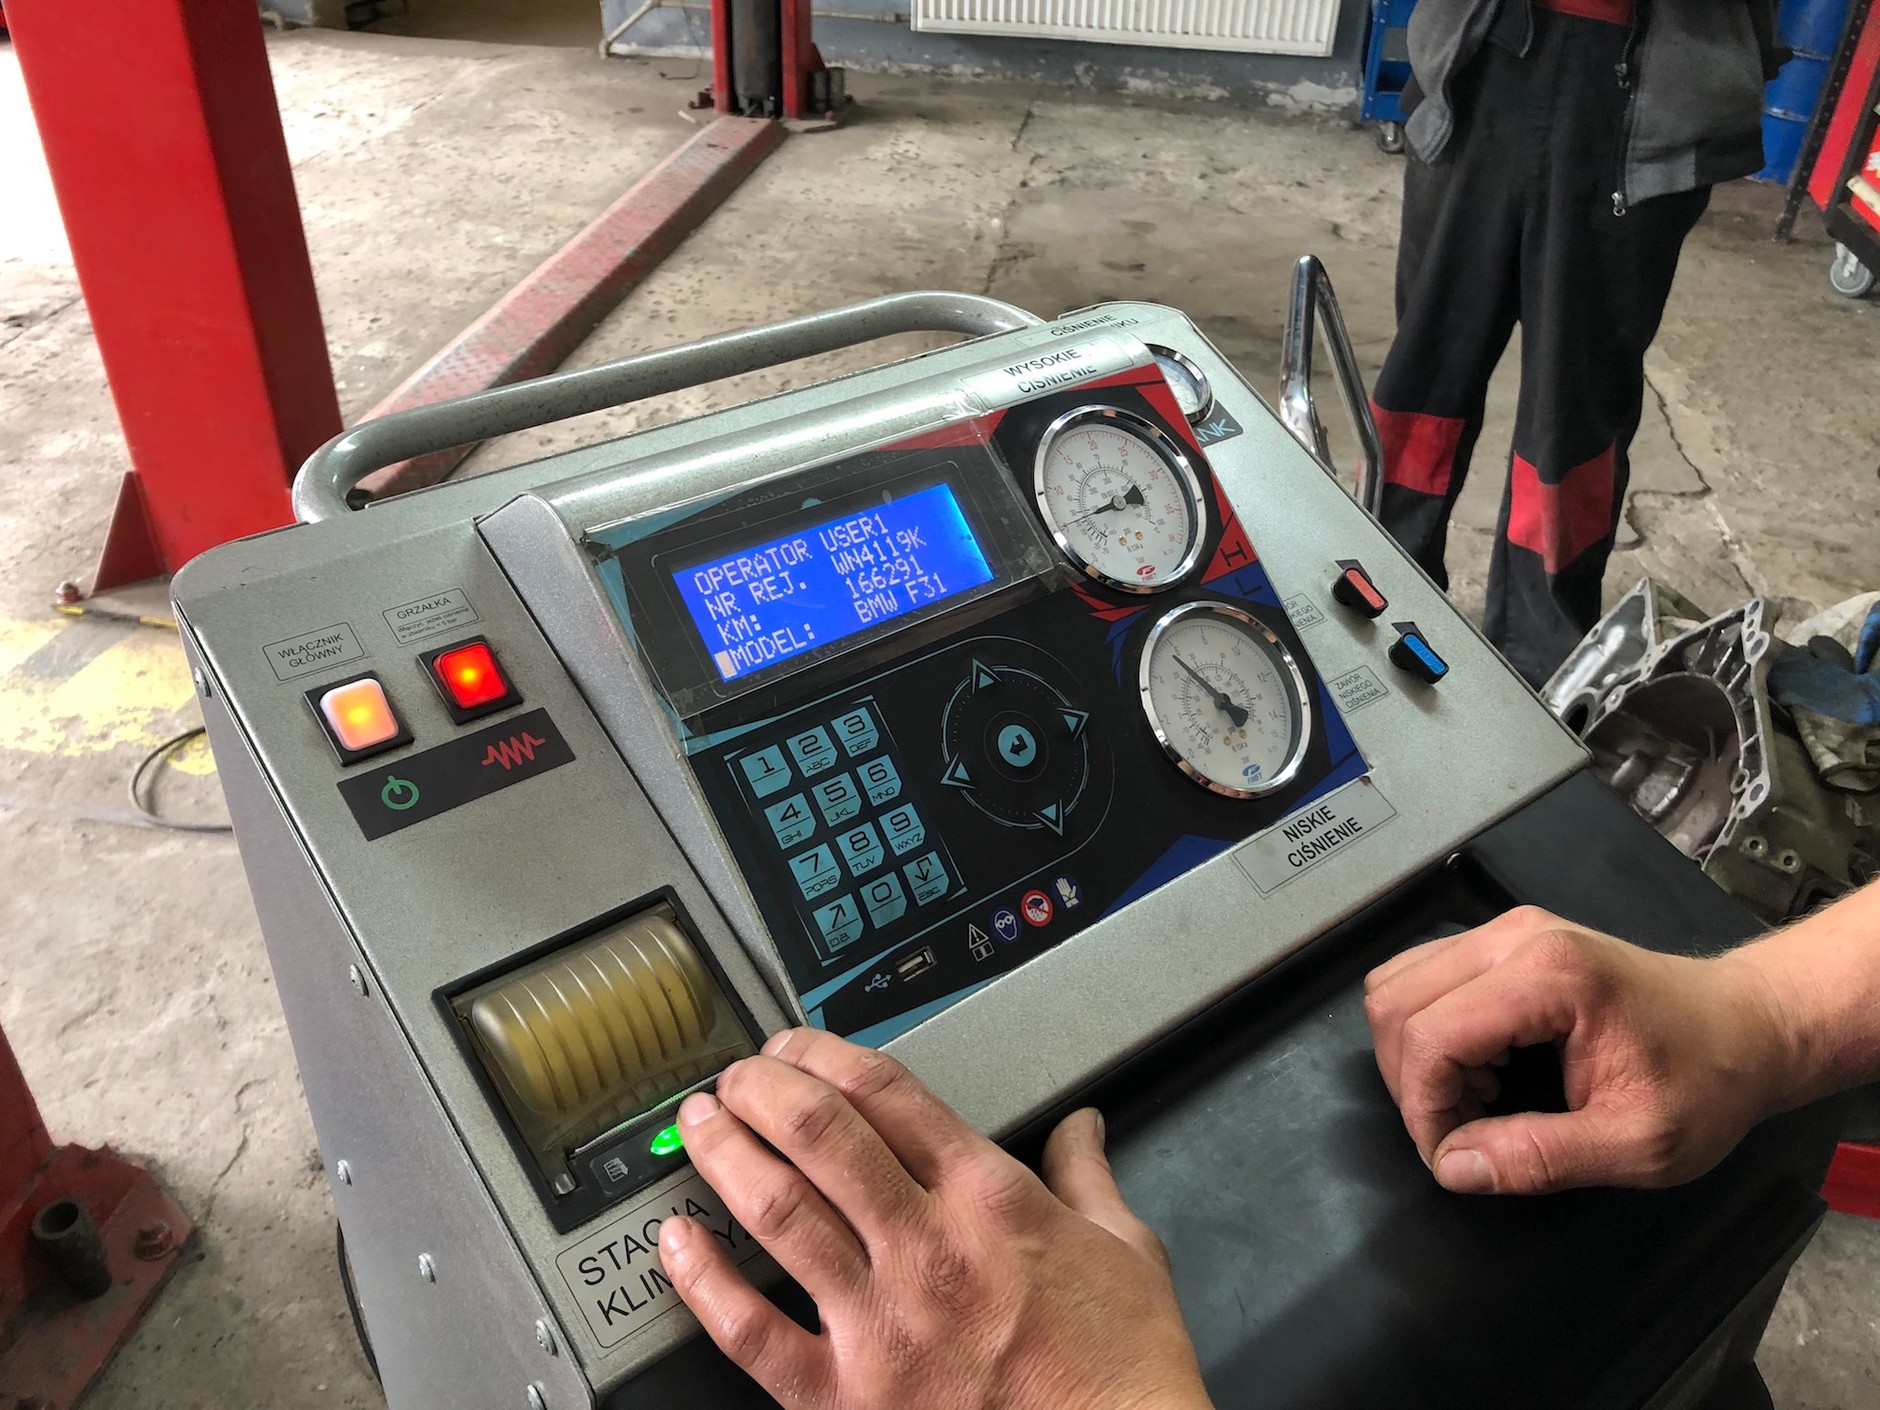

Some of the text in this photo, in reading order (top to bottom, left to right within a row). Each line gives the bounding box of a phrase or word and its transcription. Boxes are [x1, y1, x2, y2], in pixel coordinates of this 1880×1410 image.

[1003, 349, 1082, 377] WYSOKIE
[1087, 440, 1098, 451] 20
[1065, 455, 1073, 465] 15
[1054, 485, 1064, 496] 10
[694, 513, 889, 595] OPERATOR USER1
[1220, 541, 1247, 567] H
[704, 526, 927, 620] NR REJ. WN4119K
[1234, 577, 1263, 596] L
[396, 597, 451, 619] GRZAŁKA
[717, 554, 924, 645] KM: 166291
[729, 572, 947, 671] MODEL: BMW F31
[278, 633, 344, 659] WŁĄCZNIK
[289, 645, 343, 668] GŁÓWNY
[1335, 673, 1362, 690] ZAWÓR
[1338, 680, 1373, 700] NISKIEGO
[1345, 688, 1381, 708] CIŚNIENIA
[843, 714, 866, 734] 3
[798, 735, 822, 755] 2
[849, 738, 872, 753] DEF
[757, 756, 775, 774] 1
[805, 757, 830, 773] ABC
[867, 763, 888, 783] 6
[823, 780, 847, 803] 5
[872, 786, 896, 802] MNO
[780, 802, 801, 822] 4
[830, 808, 856, 822] JKL
[890, 812, 911, 832] 9
[1282, 805, 1336, 843] NISKIE
[781, 830, 803, 845] GHI
[849, 831, 870, 852] 8
[895, 833, 923, 851] WXYZ
[1287, 817, 1363, 867] CIŚNIENIE
[799, 852, 819, 873] 7
[852, 855, 875, 872] TUV
[805, 875, 838, 896] PQRS
[871, 882, 892, 903] 0
[918, 886, 941, 901] ESC
[578, 1197, 711, 1287] STACA
